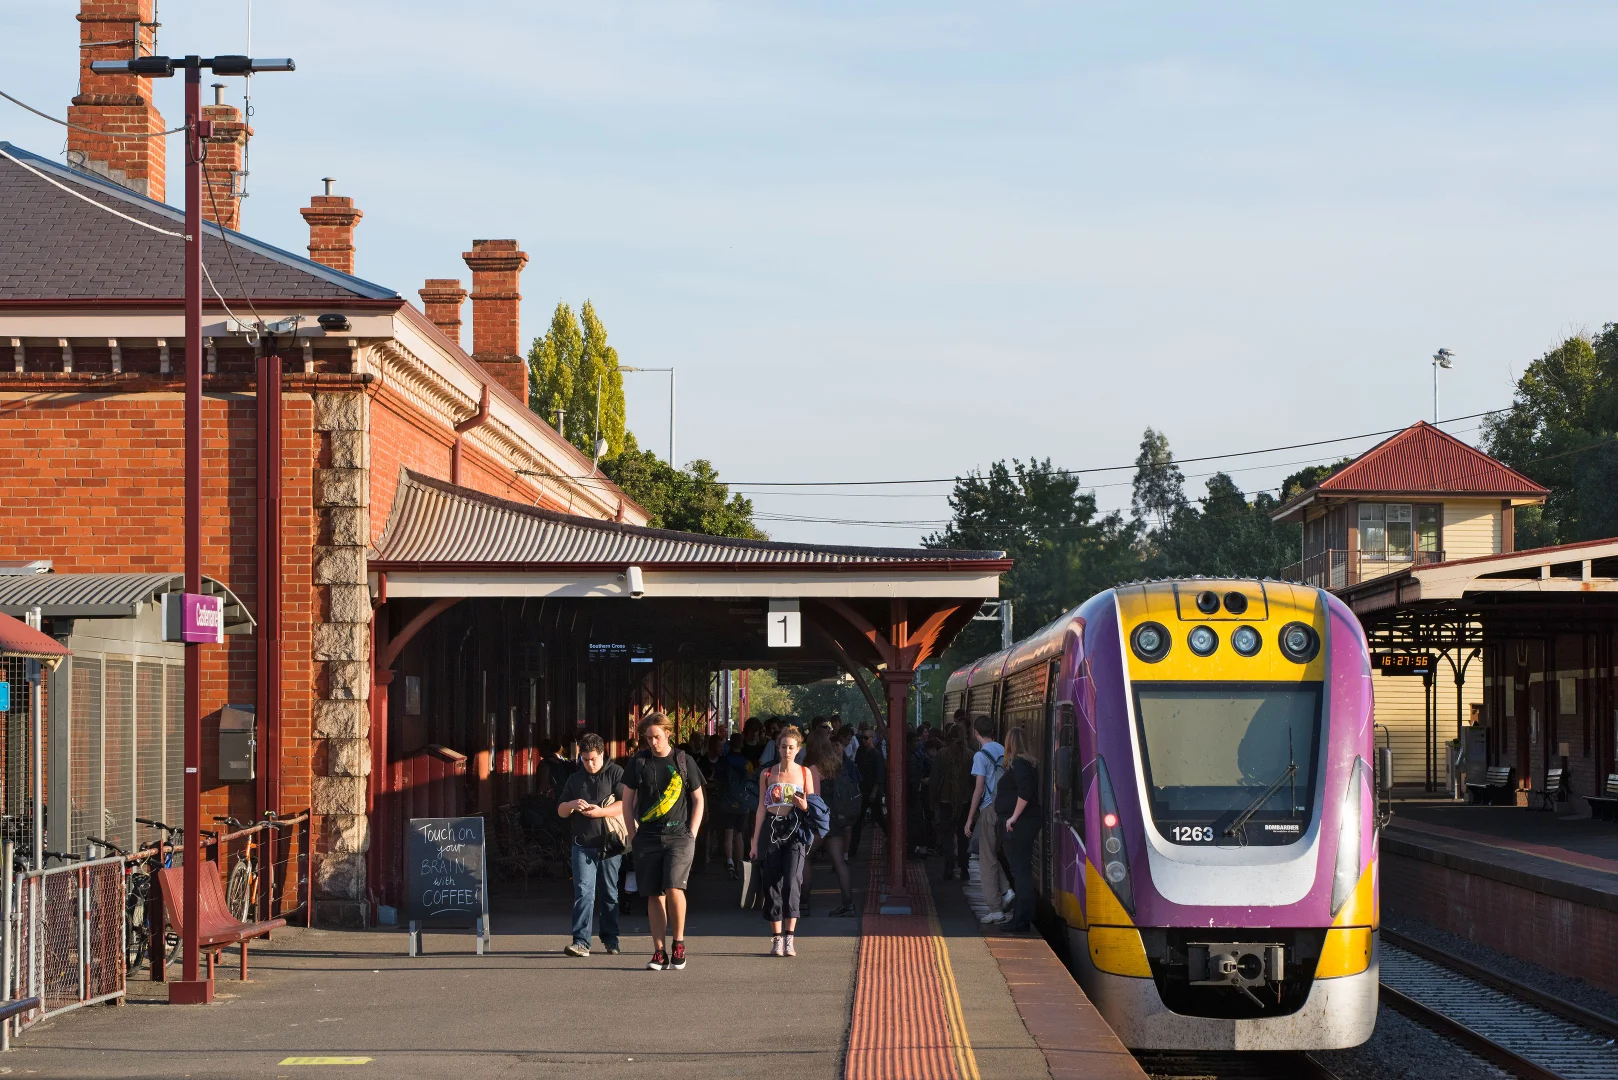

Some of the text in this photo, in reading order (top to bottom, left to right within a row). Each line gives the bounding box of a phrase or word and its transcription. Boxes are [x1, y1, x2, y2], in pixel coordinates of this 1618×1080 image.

[777, 615, 787, 643] 1
[1381, 656, 1428, 666] 16:27:56
[418, 822, 476, 844] Touch on
[1172, 826, 1214, 841] 1263
[436, 844, 465, 859] your
[420, 857, 465, 875] BRAIN
[433, 876, 456, 886] with
[422, 888, 479, 907] COFFEE!
